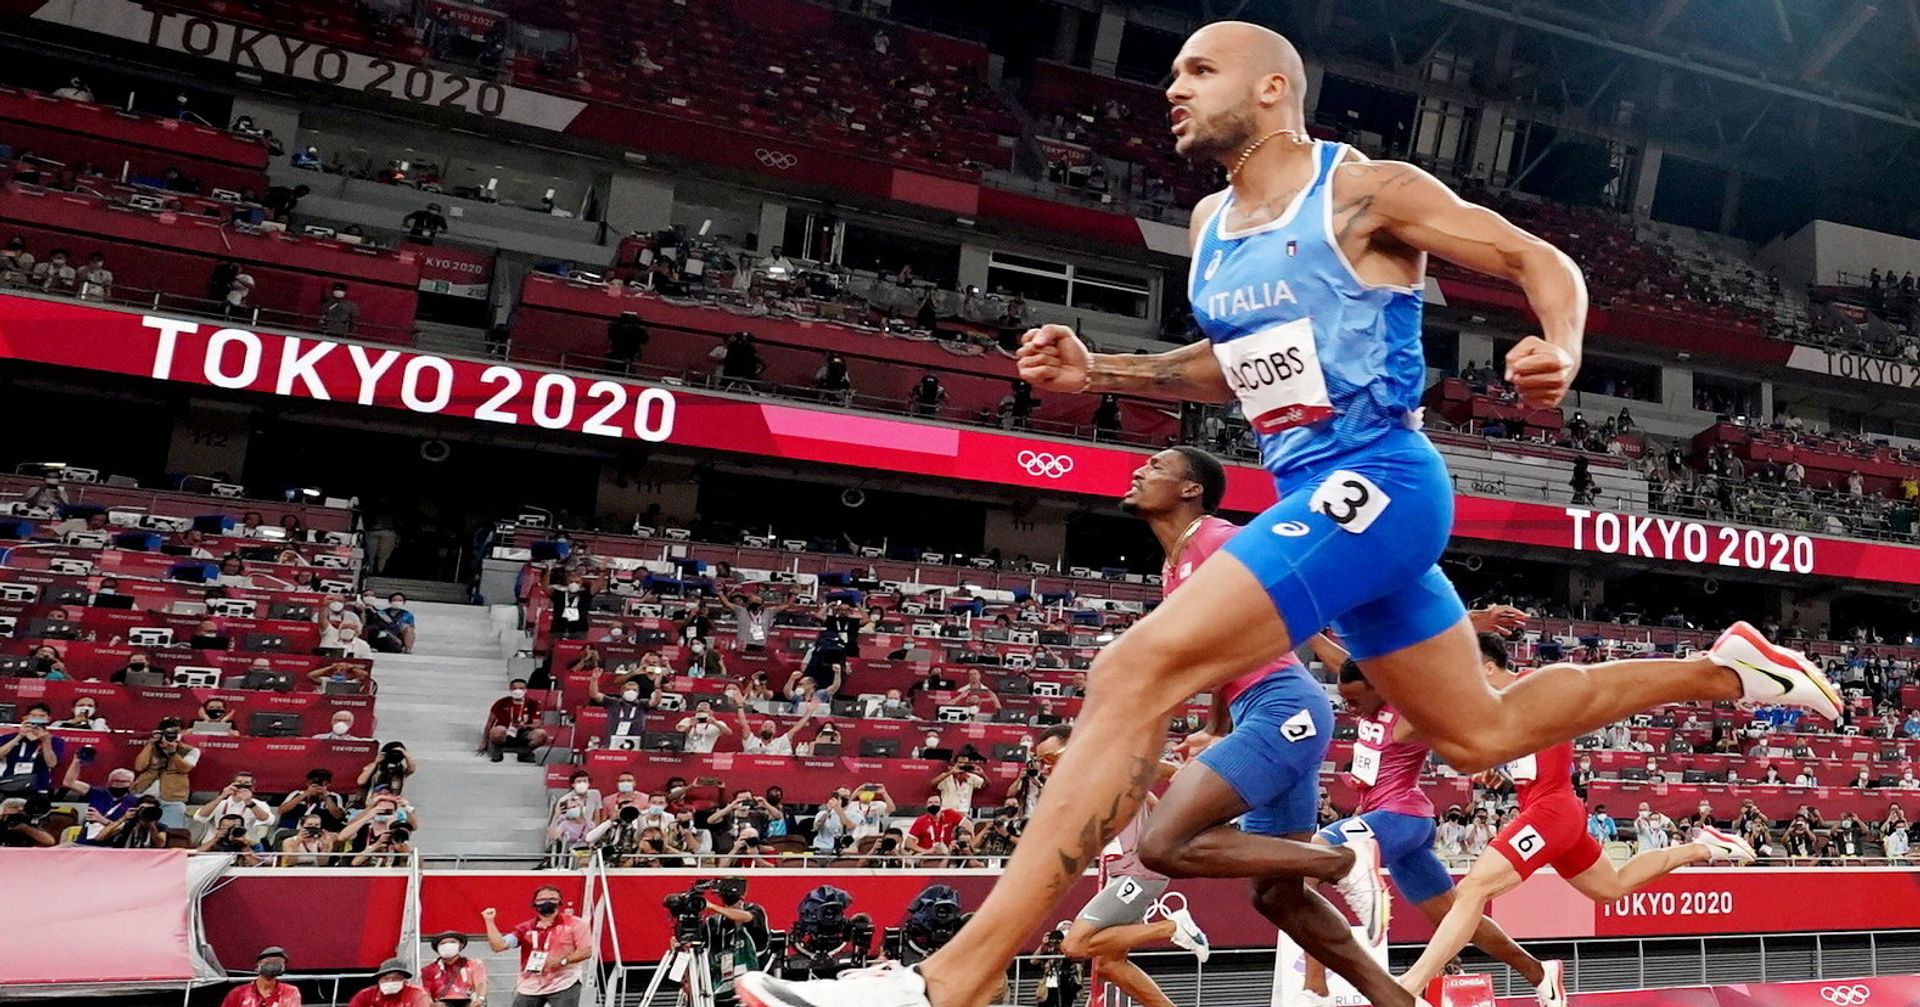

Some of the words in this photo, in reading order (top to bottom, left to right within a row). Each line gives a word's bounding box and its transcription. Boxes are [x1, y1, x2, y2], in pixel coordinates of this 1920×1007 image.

[141, 4, 348, 85] TOKYO
[364, 58, 506, 116] 2020
[1208, 279, 1297, 320] ITALIA
[142, 315, 454, 413] TOKYO
[474, 366, 676, 442] 2020
[1230, 346, 1305, 392] ACOBS
[1822, 350, 1902, 385] TOKYO
[1323, 480, 1369, 524] 3
[1566, 507, 1707, 563] TOKYO
[1718, 526, 1814, 574] 2020
[1346, 821, 1368, 835] 7
[1518, 834, 1536, 853] 6
[1122, 882, 1135, 897] 9
[1680, 891, 1733, 915] 2020
[1336, 994, 1362, 1005] RLD
[1459, 978, 1486, 986] OMEGA
